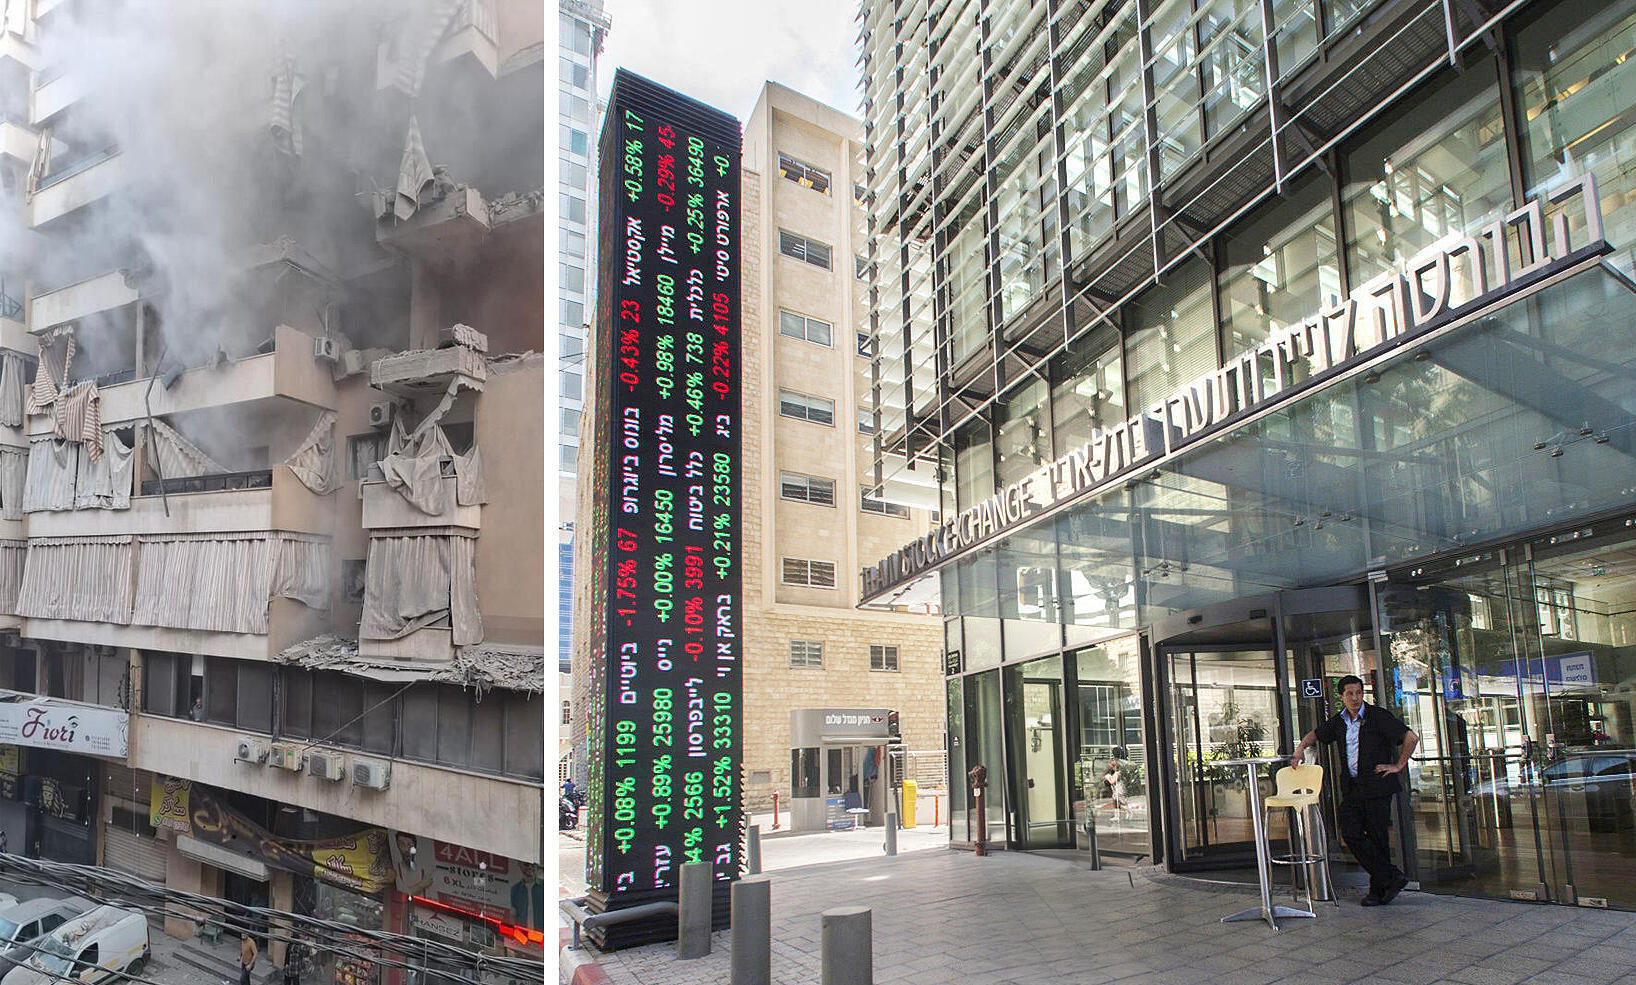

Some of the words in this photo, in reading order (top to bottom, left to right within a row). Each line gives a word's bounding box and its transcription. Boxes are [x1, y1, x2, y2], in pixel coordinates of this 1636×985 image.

[624, 140, 643, 202] +0.58%
[657, 154, 675, 211] -0.29%
[687, 136, 704, 187] 36490
[656, 224, 678, 264] מיילן
[687, 194, 704, 254] +0.25%
[716, 190, 729, 246] ארפורט
[622, 216, 645, 285] אקסטיאל
[716, 249, 729, 281] סיטי
[1370, 172, 1604, 342] הבורסה
[621, 300, 640, 323] 23
[656, 275, 674, 324] 18460
[686, 269, 703, 321] כלכלית
[713, 293, 730, 335] 4105
[620, 330, 639, 392] -0.43%
[656, 335, 674, 399] +0.98%
[685, 332, 703, 363] 738
[712, 342, 729, 400] -0.22%
[1217, 292, 1357, 422] לניירות
[623, 407, 639, 449] בונוס
[686, 372, 704, 436] +0.46%
[716, 415, 730, 438] ביג
[1152, 379, 1213, 456] ערך
[654, 414, 677, 477] מליסרון
[684, 451, 703, 478] כלל
[688, 485, 703, 530] ביטוח
[712, 453, 730, 506] 23580
[618, 528, 637, 551] 67
[654, 490, 674, 543] 16450
[902, 526, 947, 575] STOCK
[946, 477, 1033, 552] EXCHANGE
[684, 546, 703, 589] 3991
[713, 513, 731, 579] +0.21%
[616, 560, 637, 626] -1.75%
[653, 553, 673, 623] +0.00%
[657, 639, 672, 671] נייס
[684, 597, 703, 662] -0.10%
[619, 643, 637, 704] ביוטיים
[22, 707, 77, 743] Fiori
[616, 721, 636, 767] 1199
[652, 688, 674, 746] 25980
[684, 678, 707, 757] לייבפרסון
[713, 693, 732, 749] 33310
[614, 776, 636, 854] +0.08%
[652, 755, 672, 829] +0.89%
[683, 772, 703, 819] 2566
[712, 757, 731, 828] +1.52%
[450, 866, 494, 882] stores
[716, 843, 732, 864] גב
